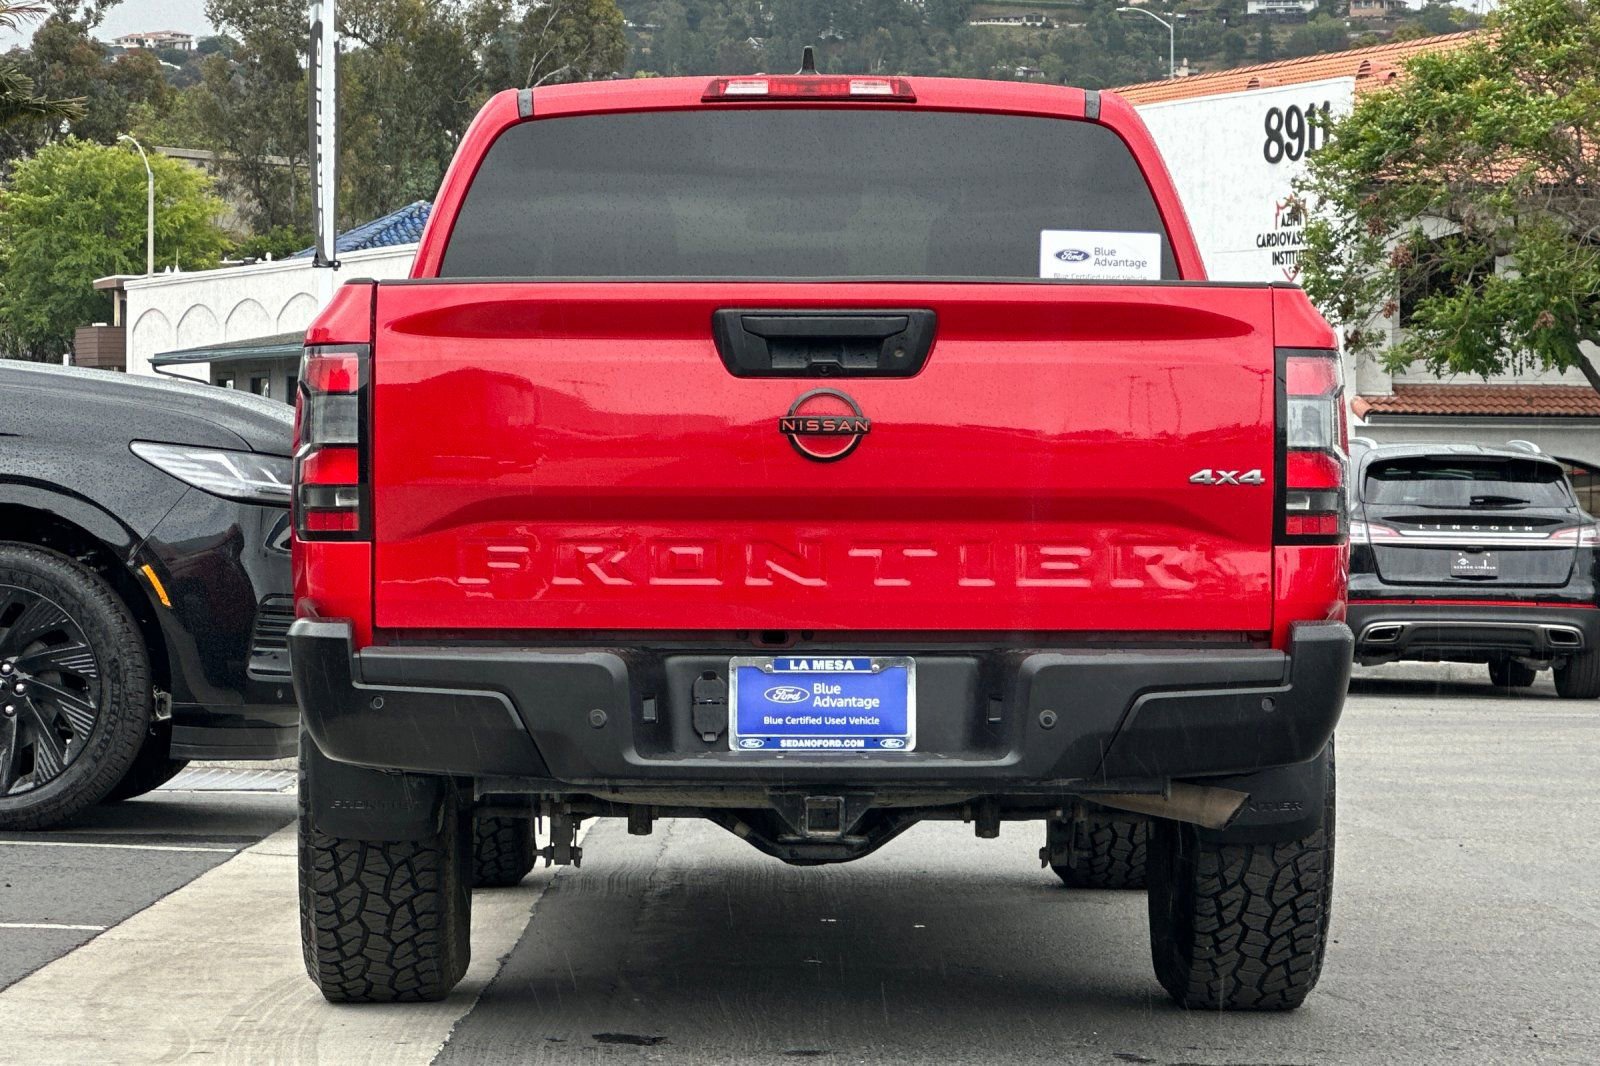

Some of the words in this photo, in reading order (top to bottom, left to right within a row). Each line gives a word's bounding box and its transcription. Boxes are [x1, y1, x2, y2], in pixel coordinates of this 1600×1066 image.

[1094, 247, 1117, 256] Blue
[1094, 258, 1148, 269] Advantage
[782, 420, 868, 431] NISSAN
[456, 538, 1198, 587] FRONTIER
[789, 659, 809, 670] LA
[813, 660, 855, 670] MESA
[813, 683, 841, 694] Blue
[813, 696, 880, 709] Advantage
[764, 716, 783, 724] Blue
[785, 716, 822, 724] Certified
[824, 716, 846, 724] Used
[849, 716, 880, 724] Vehicle
[780, 739, 865, 747] SEDANOFORD.COM
